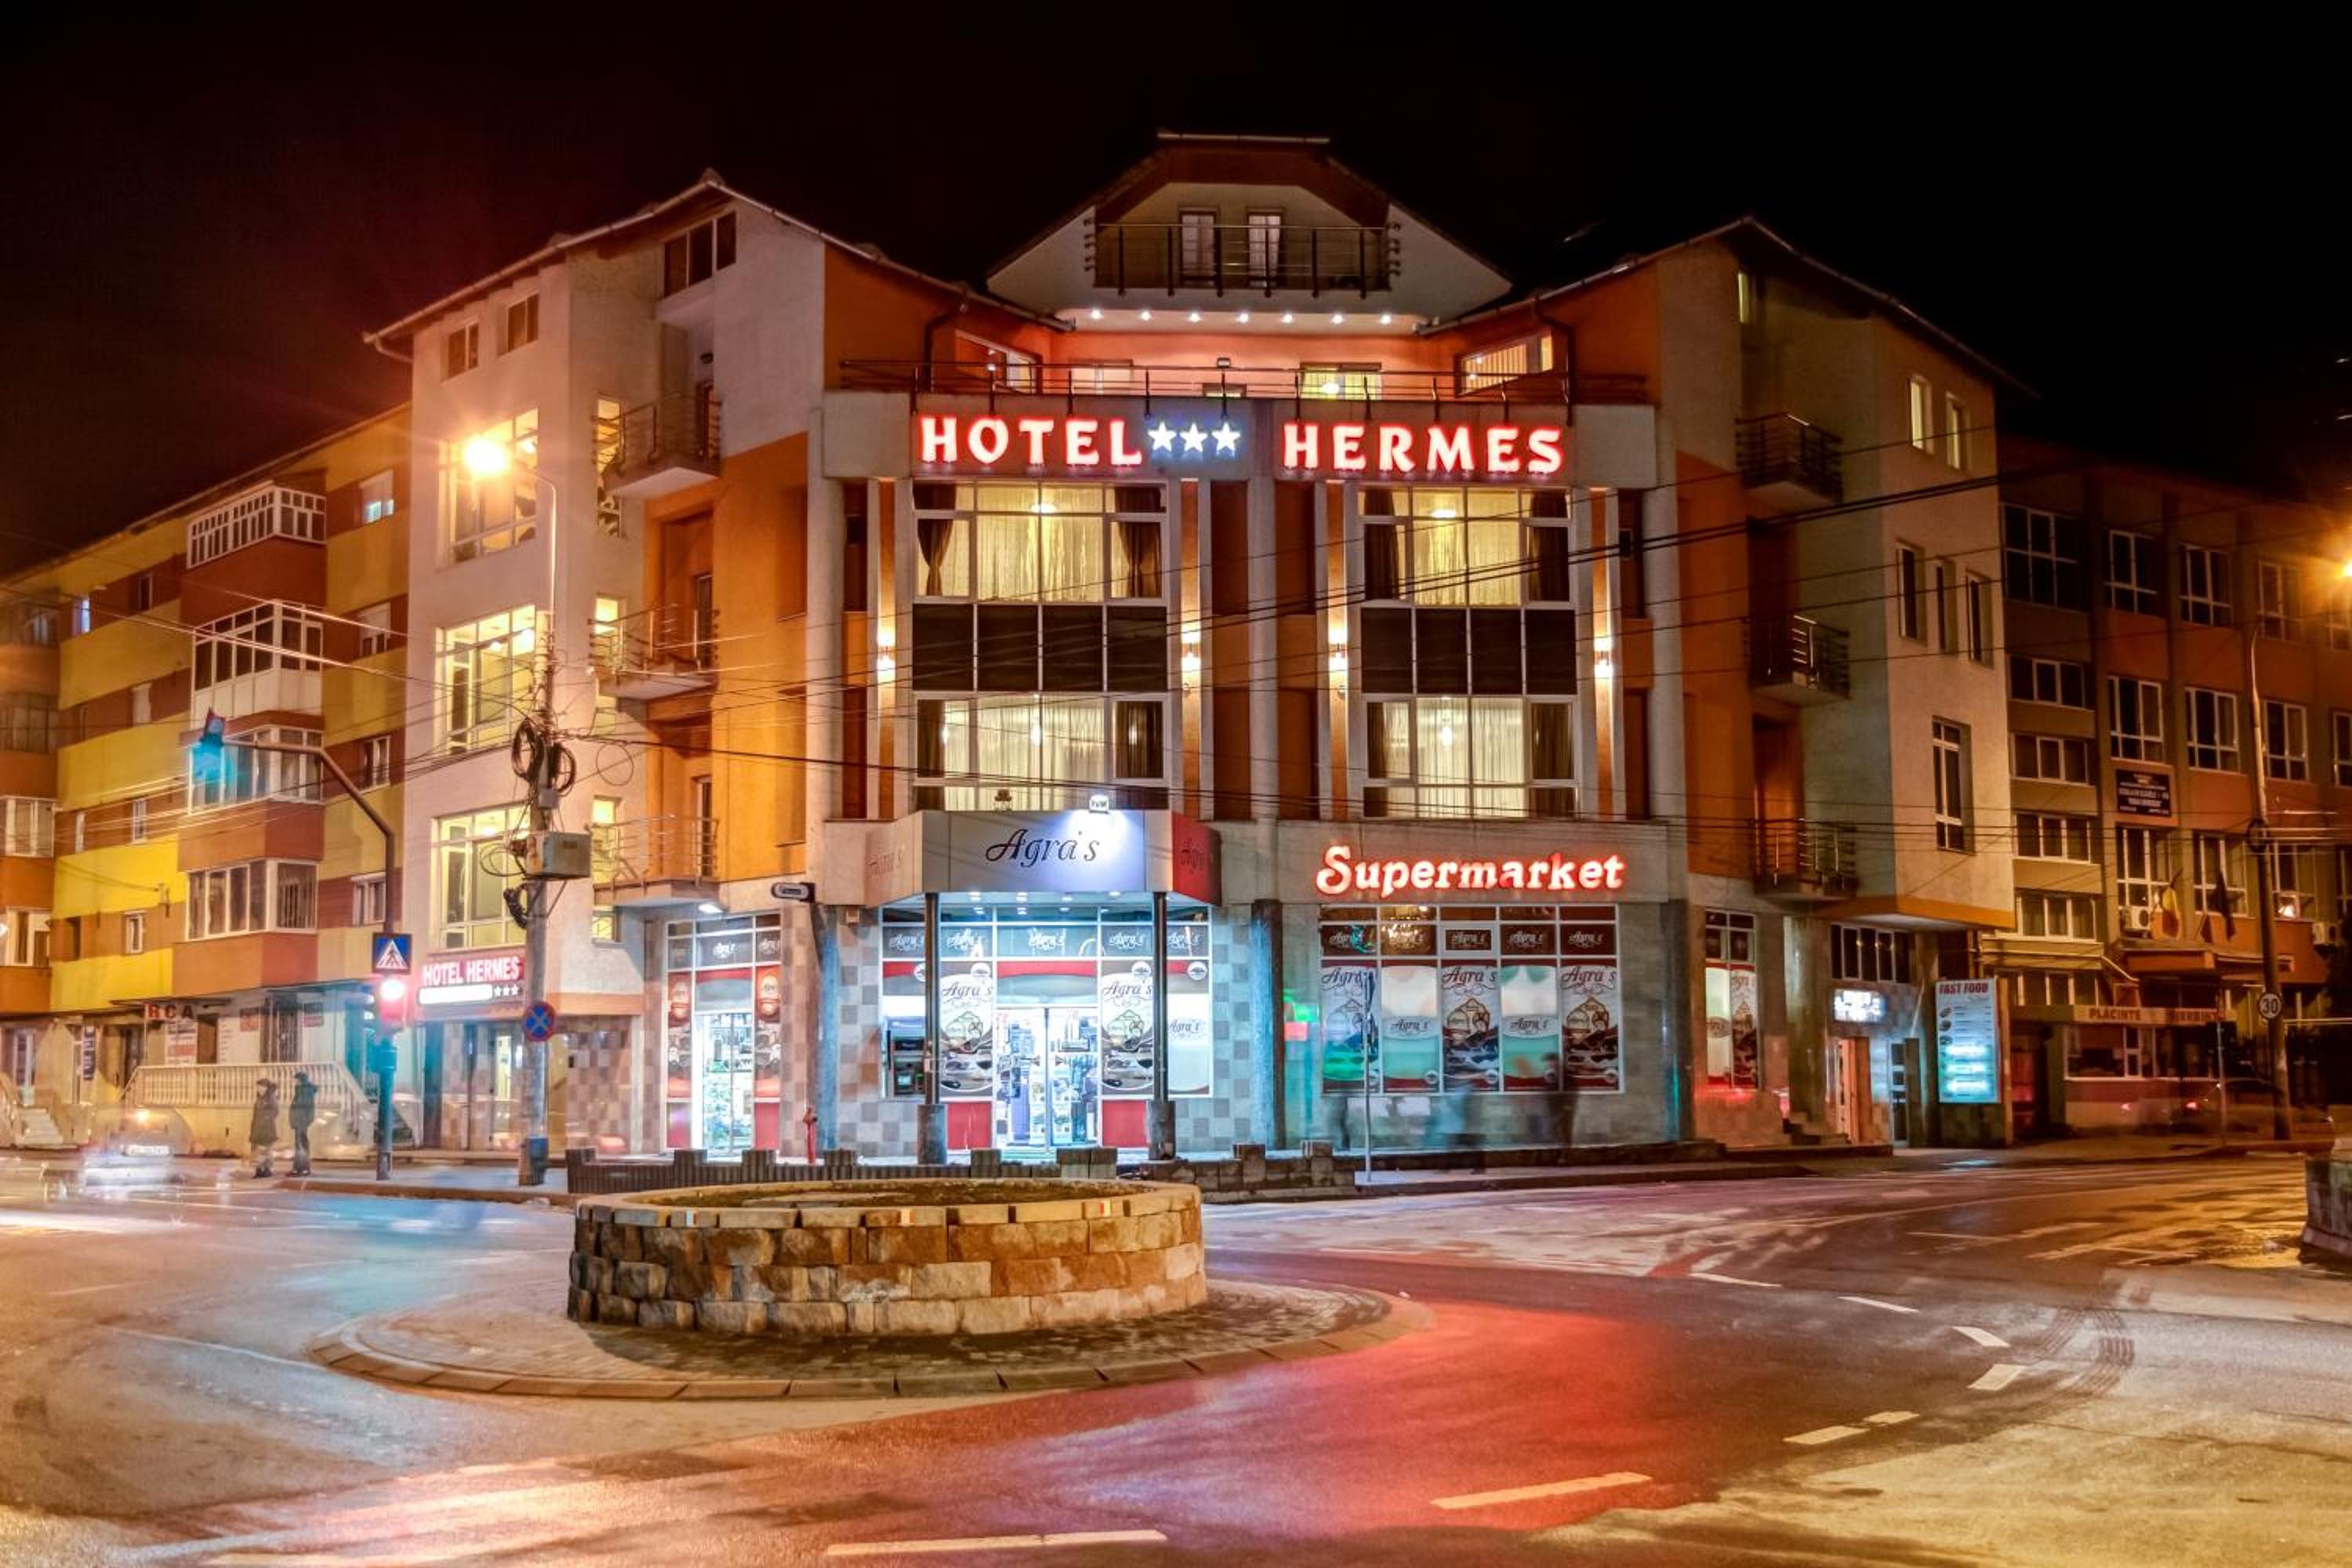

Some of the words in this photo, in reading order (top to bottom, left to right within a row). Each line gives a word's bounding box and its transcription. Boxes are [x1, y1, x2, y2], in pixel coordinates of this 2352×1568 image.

[921, 416, 1142, 465] HOTEL
[1283, 424, 1563, 474] HERMES
[985, 829, 1099, 868] Agra's
[1316, 846, 1625, 898] Supermarket
[1109, 932, 1145, 947] Agra's
[1452, 931, 1484, 945] Agra's
[1510, 931, 1543, 945] Agra's
[1570, 931, 1602, 945] Agra's
[422, 963, 463, 986] HOTEL
[466, 956, 520, 982] HERMES
[1443, 966, 1497, 985] Agra's
[1562, 966, 1617, 985] Agra's
[942, 982, 992, 1000] Agra's
[1102, 980, 1152, 998] Agra's
[1939, 984, 1960, 994] FAST
[1963, 983, 1989, 993] FOOD
[2262, 998, 2278, 1014] 30
[1391, 1018, 1430, 1030] Agra's
[1510, 1018, 1548, 1030] Agra's
